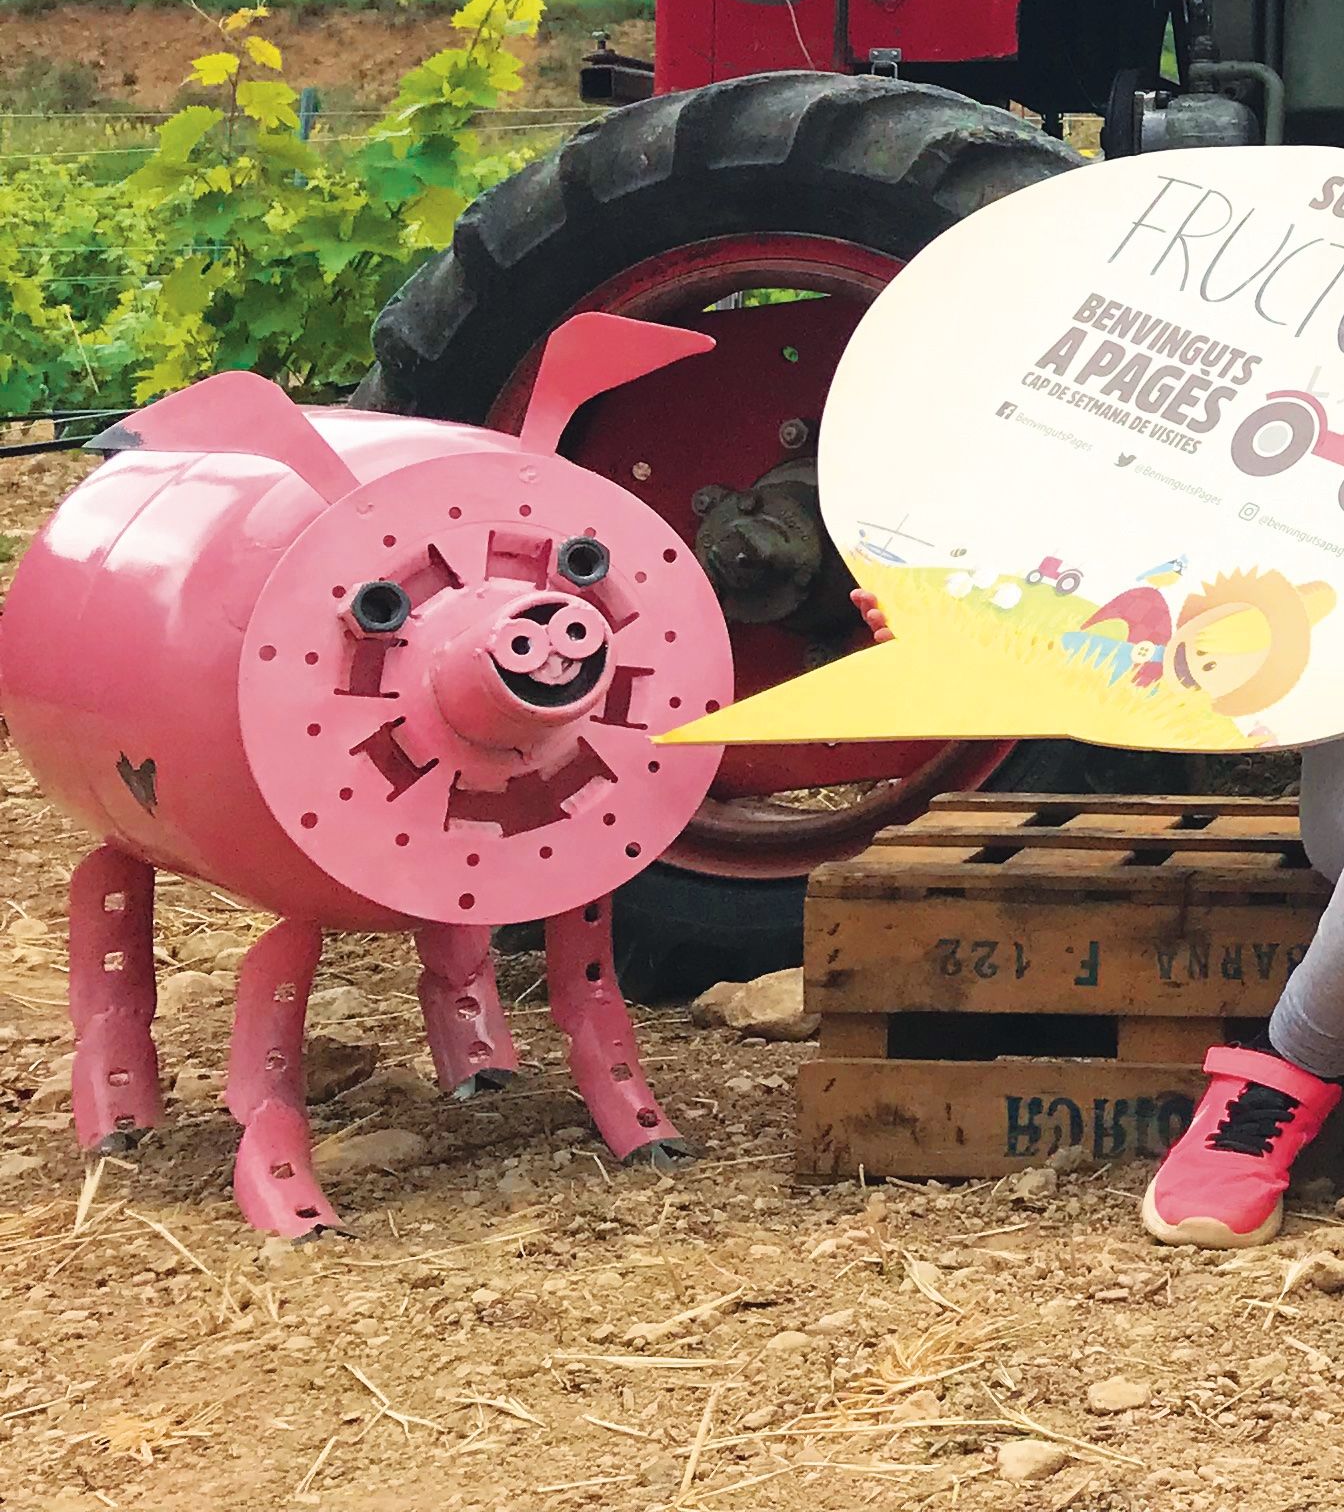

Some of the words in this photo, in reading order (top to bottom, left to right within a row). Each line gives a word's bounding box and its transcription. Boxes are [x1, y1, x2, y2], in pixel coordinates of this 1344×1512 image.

[1034, 326, 1088, 377] A
[1073, 339, 1238, 434] PAGÈS
[1072, 292, 1263, 386] BENVINGUTS
[1020, 371, 1051, 392] CAP
[1047, 382, 1071, 401] DE
[1065, 389, 1132, 427] SETMANA
[1128, 414, 1152, 435] DE
[1149, 423, 1202, 455] VISITES
[935, 938, 1027, 980] 122
